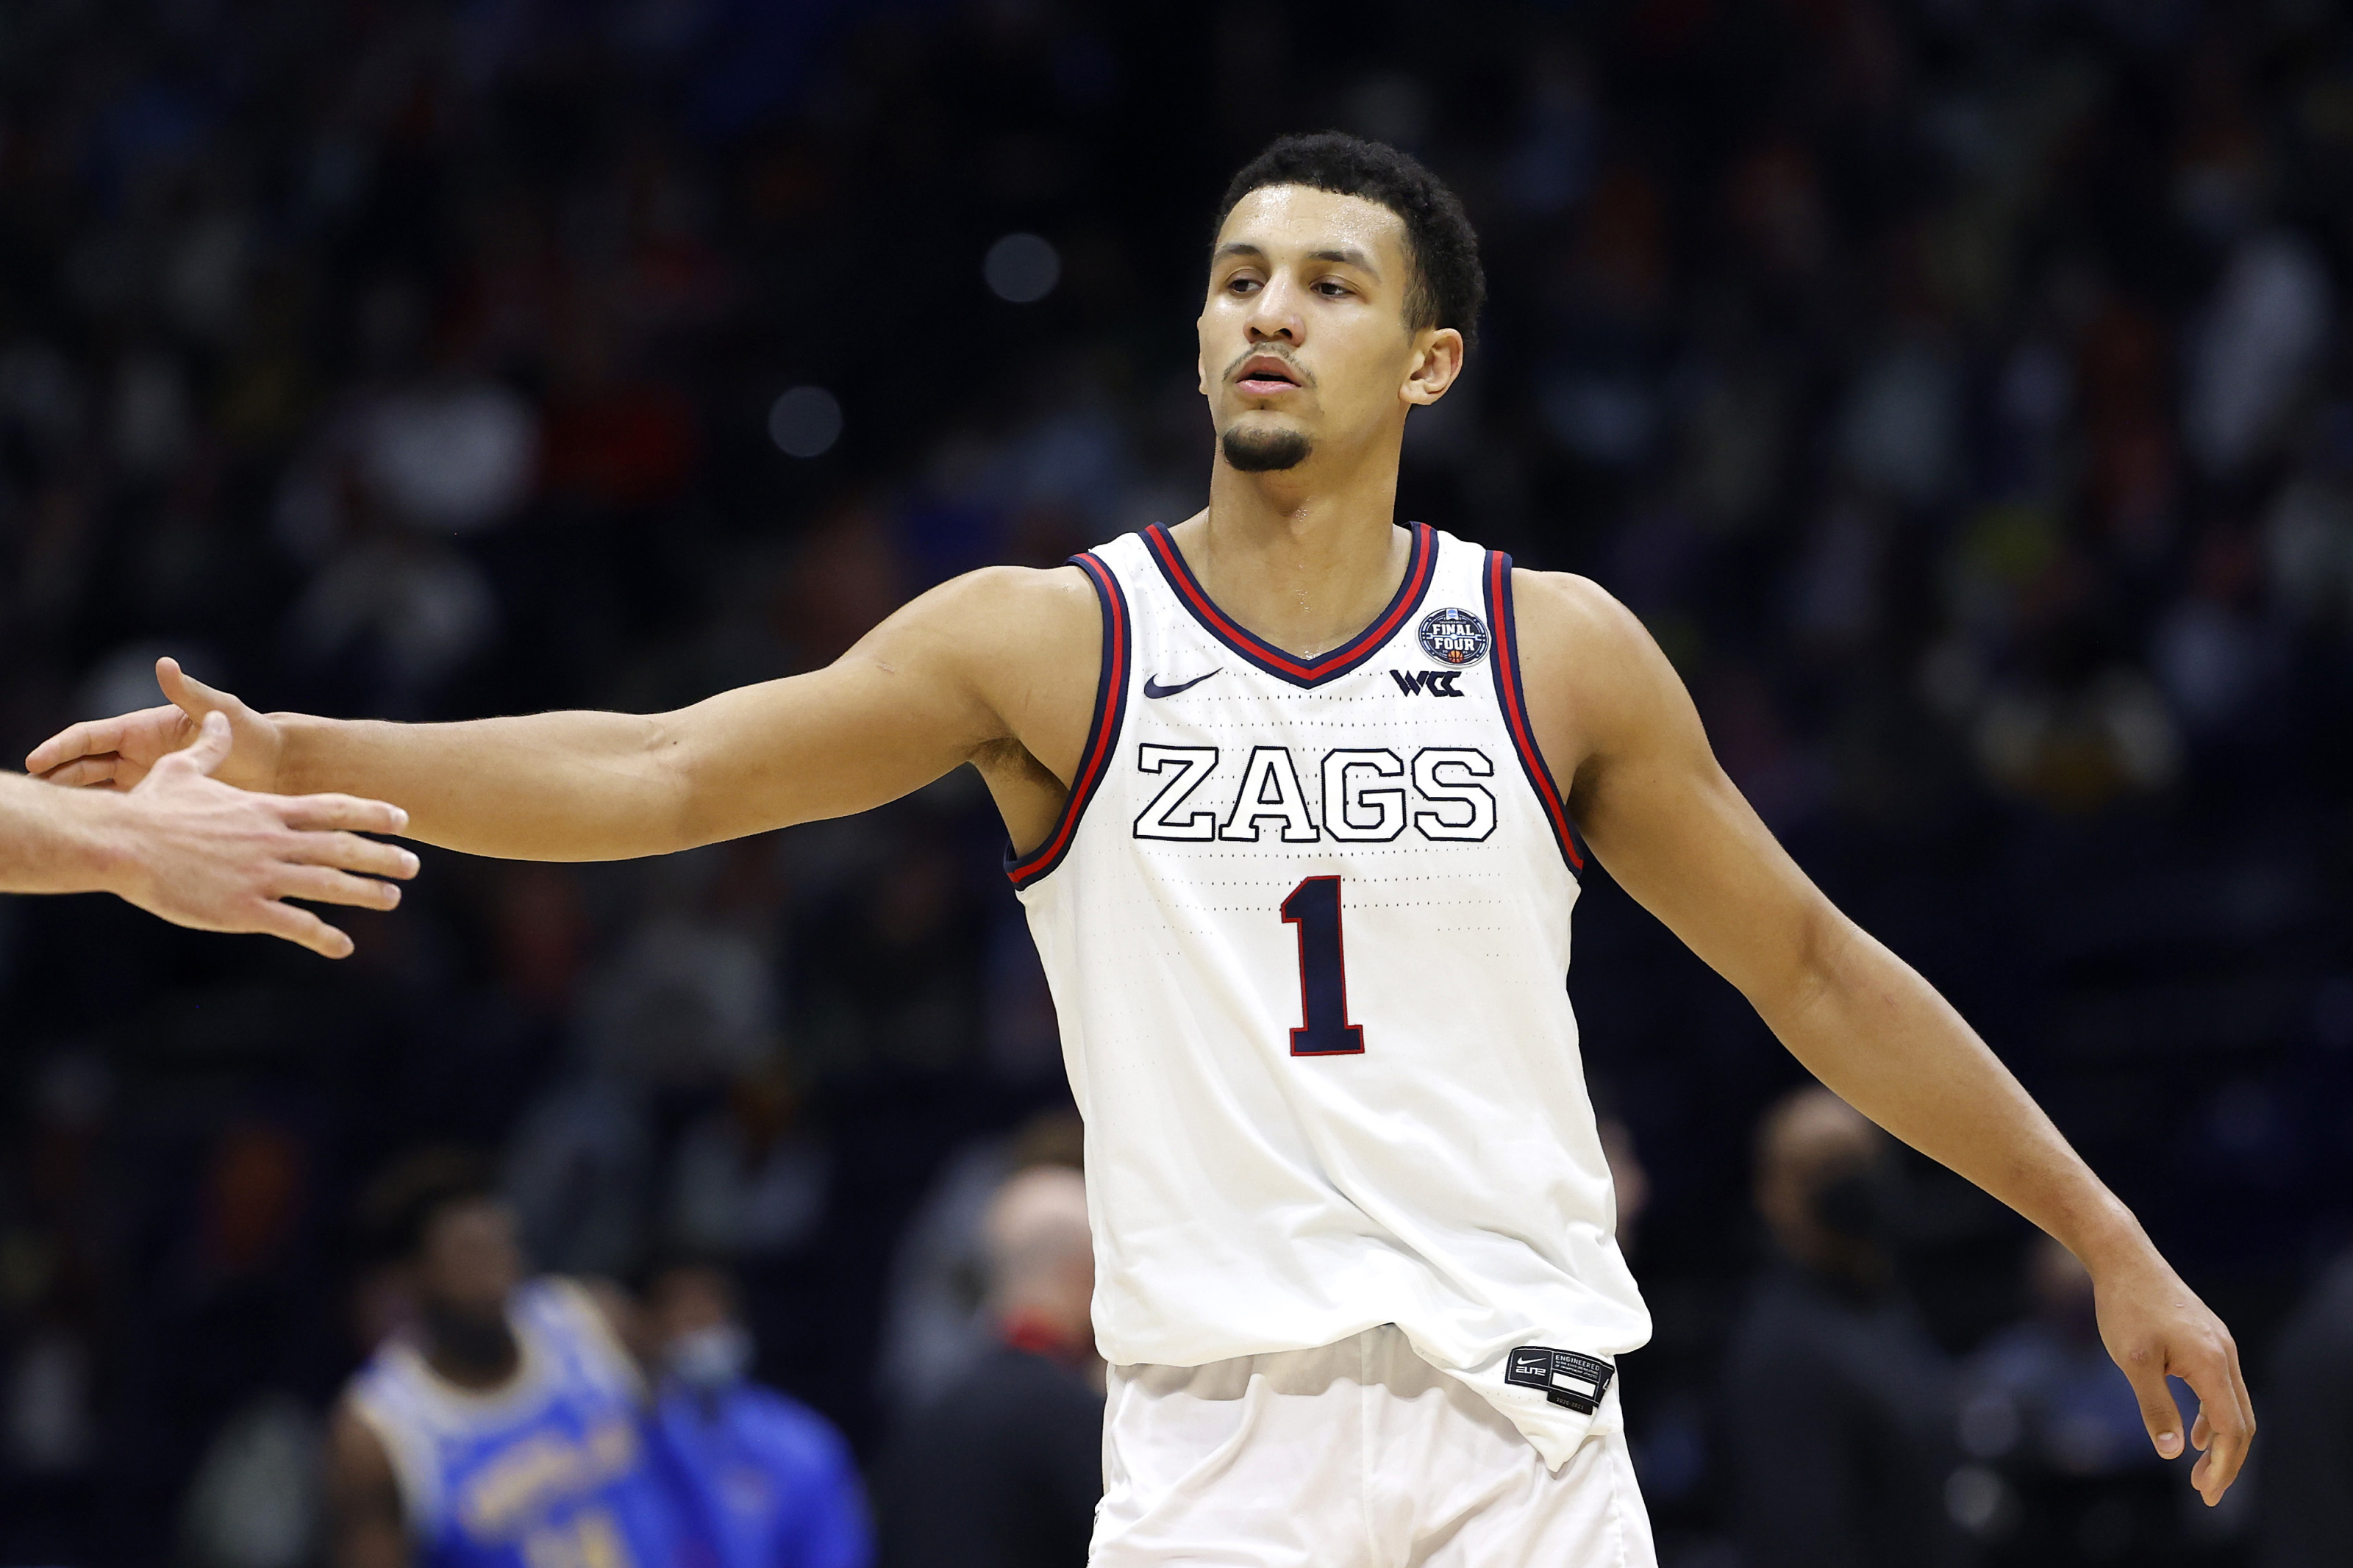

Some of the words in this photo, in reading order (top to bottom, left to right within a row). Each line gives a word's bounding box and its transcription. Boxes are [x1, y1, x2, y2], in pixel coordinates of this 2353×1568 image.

[1432, 624, 1474, 636] FINAL
[1435, 637, 1475, 651] FOUR
[1389, 670, 1465, 697] WCC
[1133, 743, 1497, 842] ZAGS
[1280, 875, 1365, 1056] 1
[1555, 1355, 1600, 1371] ENGINEERED
